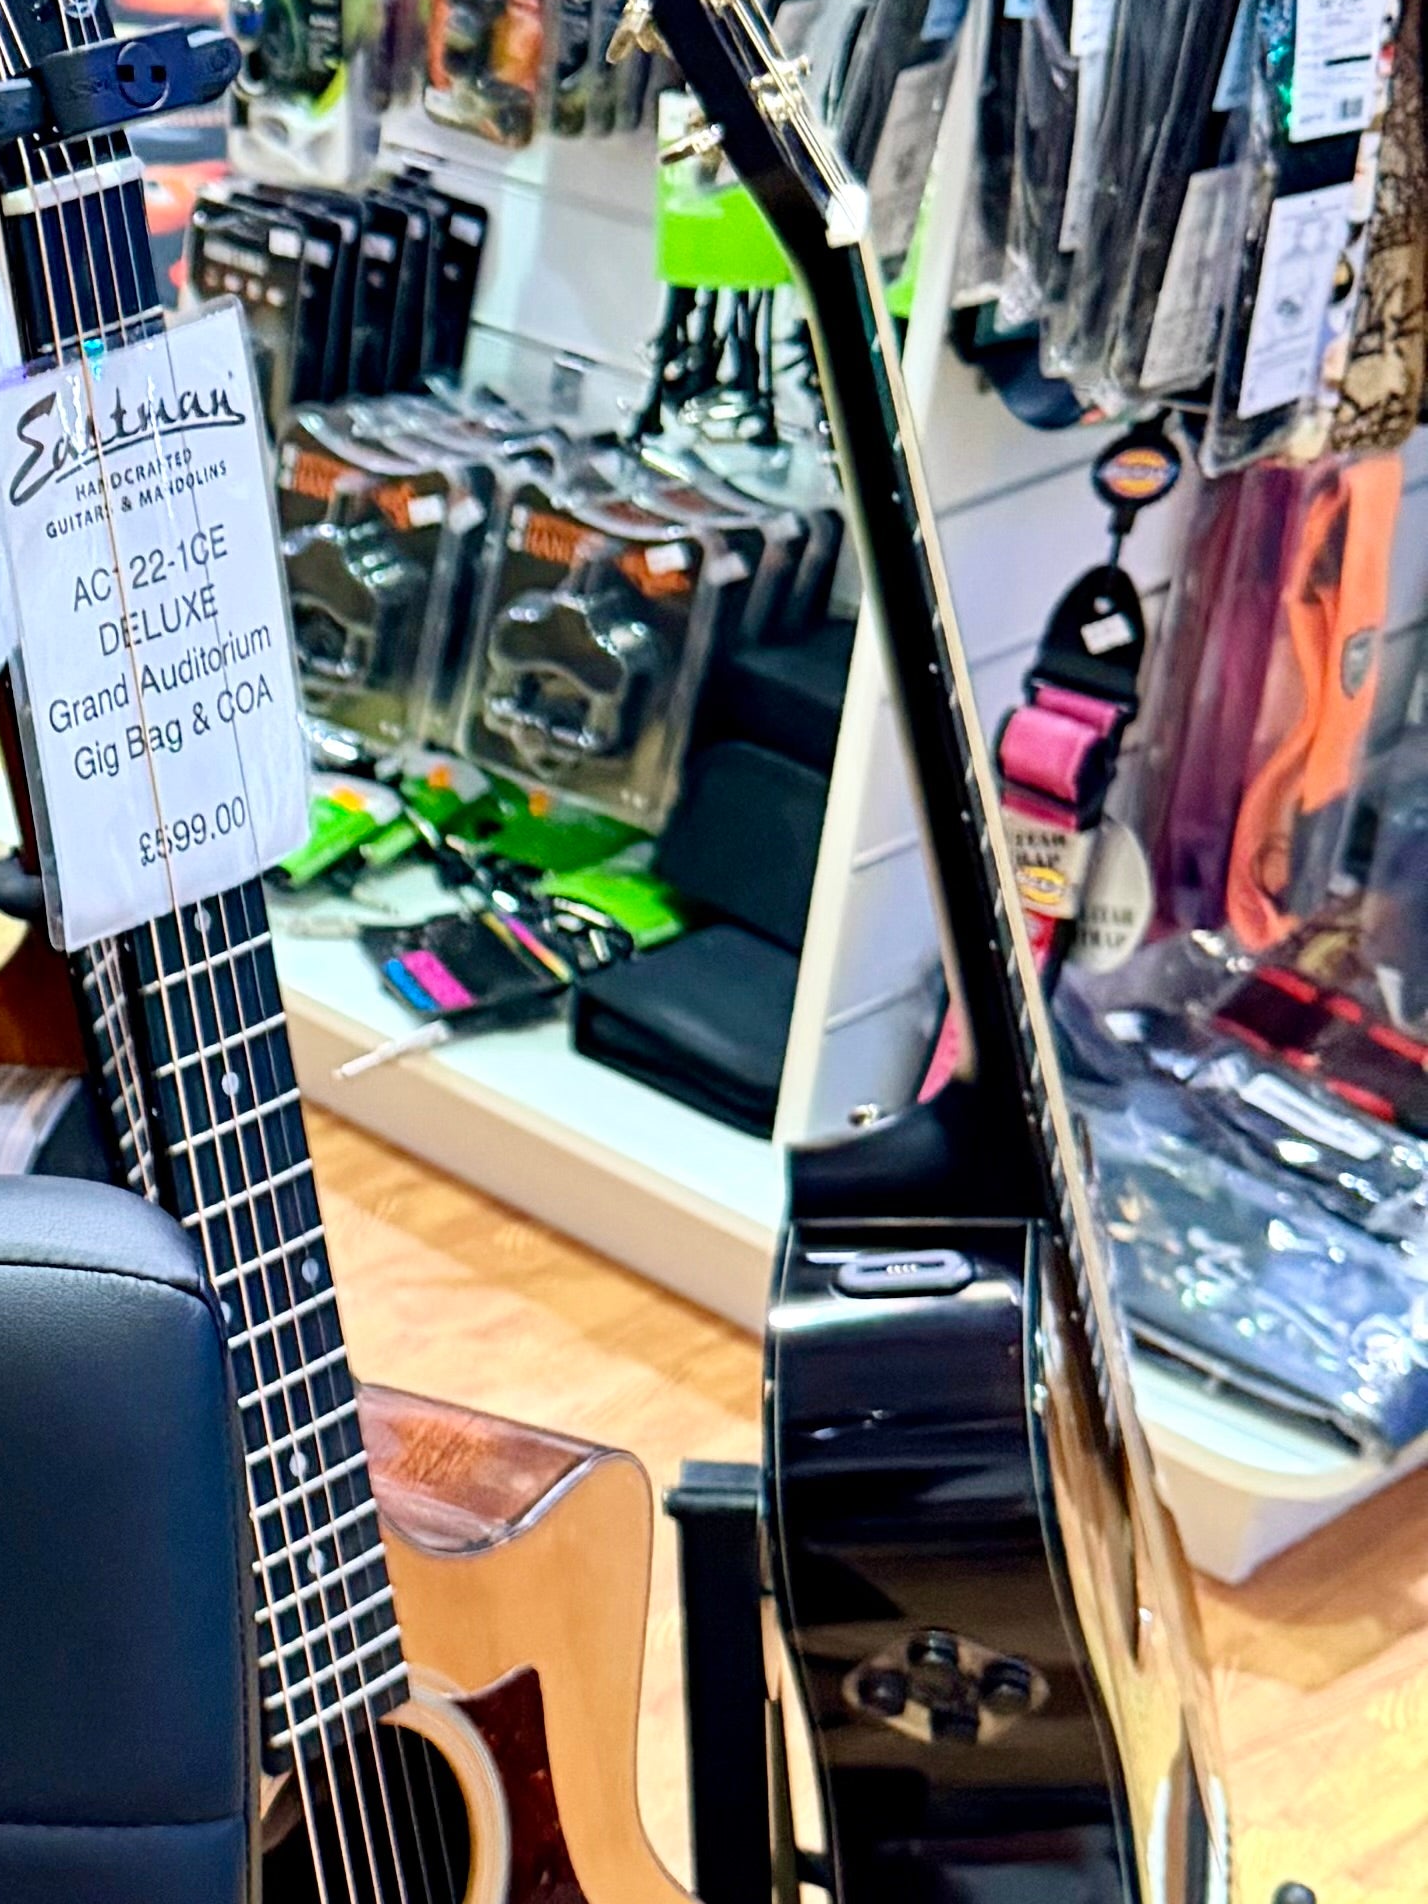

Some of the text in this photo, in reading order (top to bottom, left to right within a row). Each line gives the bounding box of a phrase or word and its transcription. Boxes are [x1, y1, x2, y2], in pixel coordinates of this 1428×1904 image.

[120, 495, 133, 513] &
[73, 524, 228, 613] AC22-1CE
[98, 584, 219, 657] DELUXE
[48, 624, 272, 734] Grand Auditorium
[74, 673, 274, 781] Gig Bag & COA
[138, 796, 247, 867] £599.00
